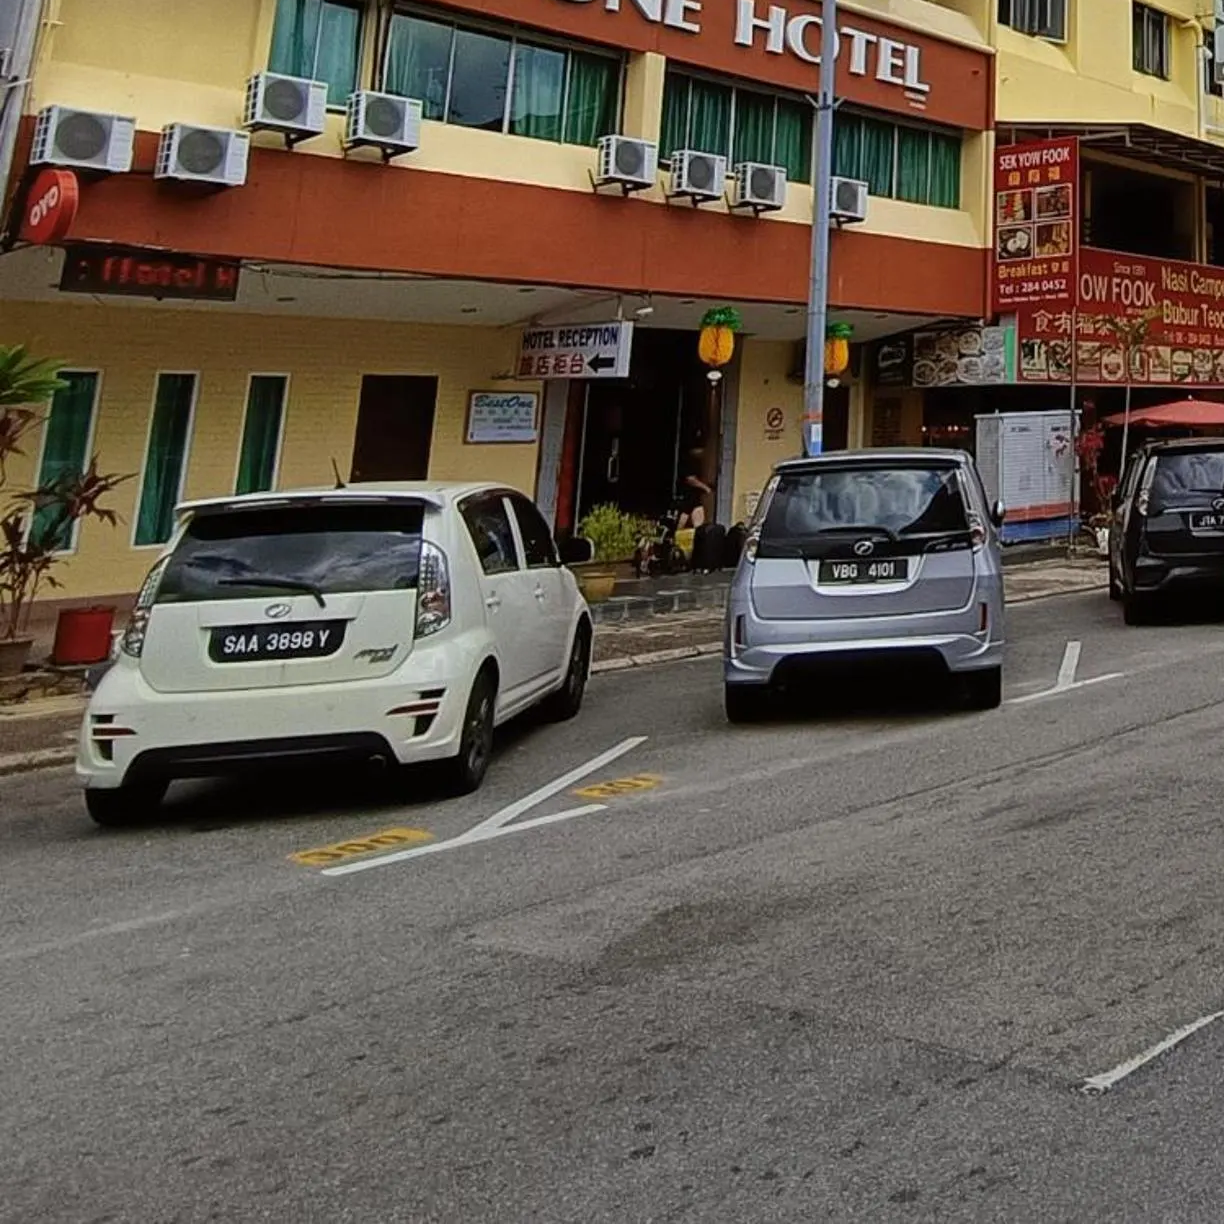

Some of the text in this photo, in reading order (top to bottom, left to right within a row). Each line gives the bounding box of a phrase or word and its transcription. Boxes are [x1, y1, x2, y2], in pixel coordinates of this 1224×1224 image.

[1000, 147, 1070, 171] SEK YOW FOOK
[30, 185, 58, 227] OYO
[1021, 281, 1040, 293] 284
[1161, 265, 1189, 292] Nasi
[1112, 278, 1156, 307] FOOK
[1162, 299, 1199, 326] Bubur
[523, 326, 619, 351] HOTEL RECEPTION
[832, 562, 895, 579] VBG 4101
[224, 629, 331, 654] SAA 3898 Y
